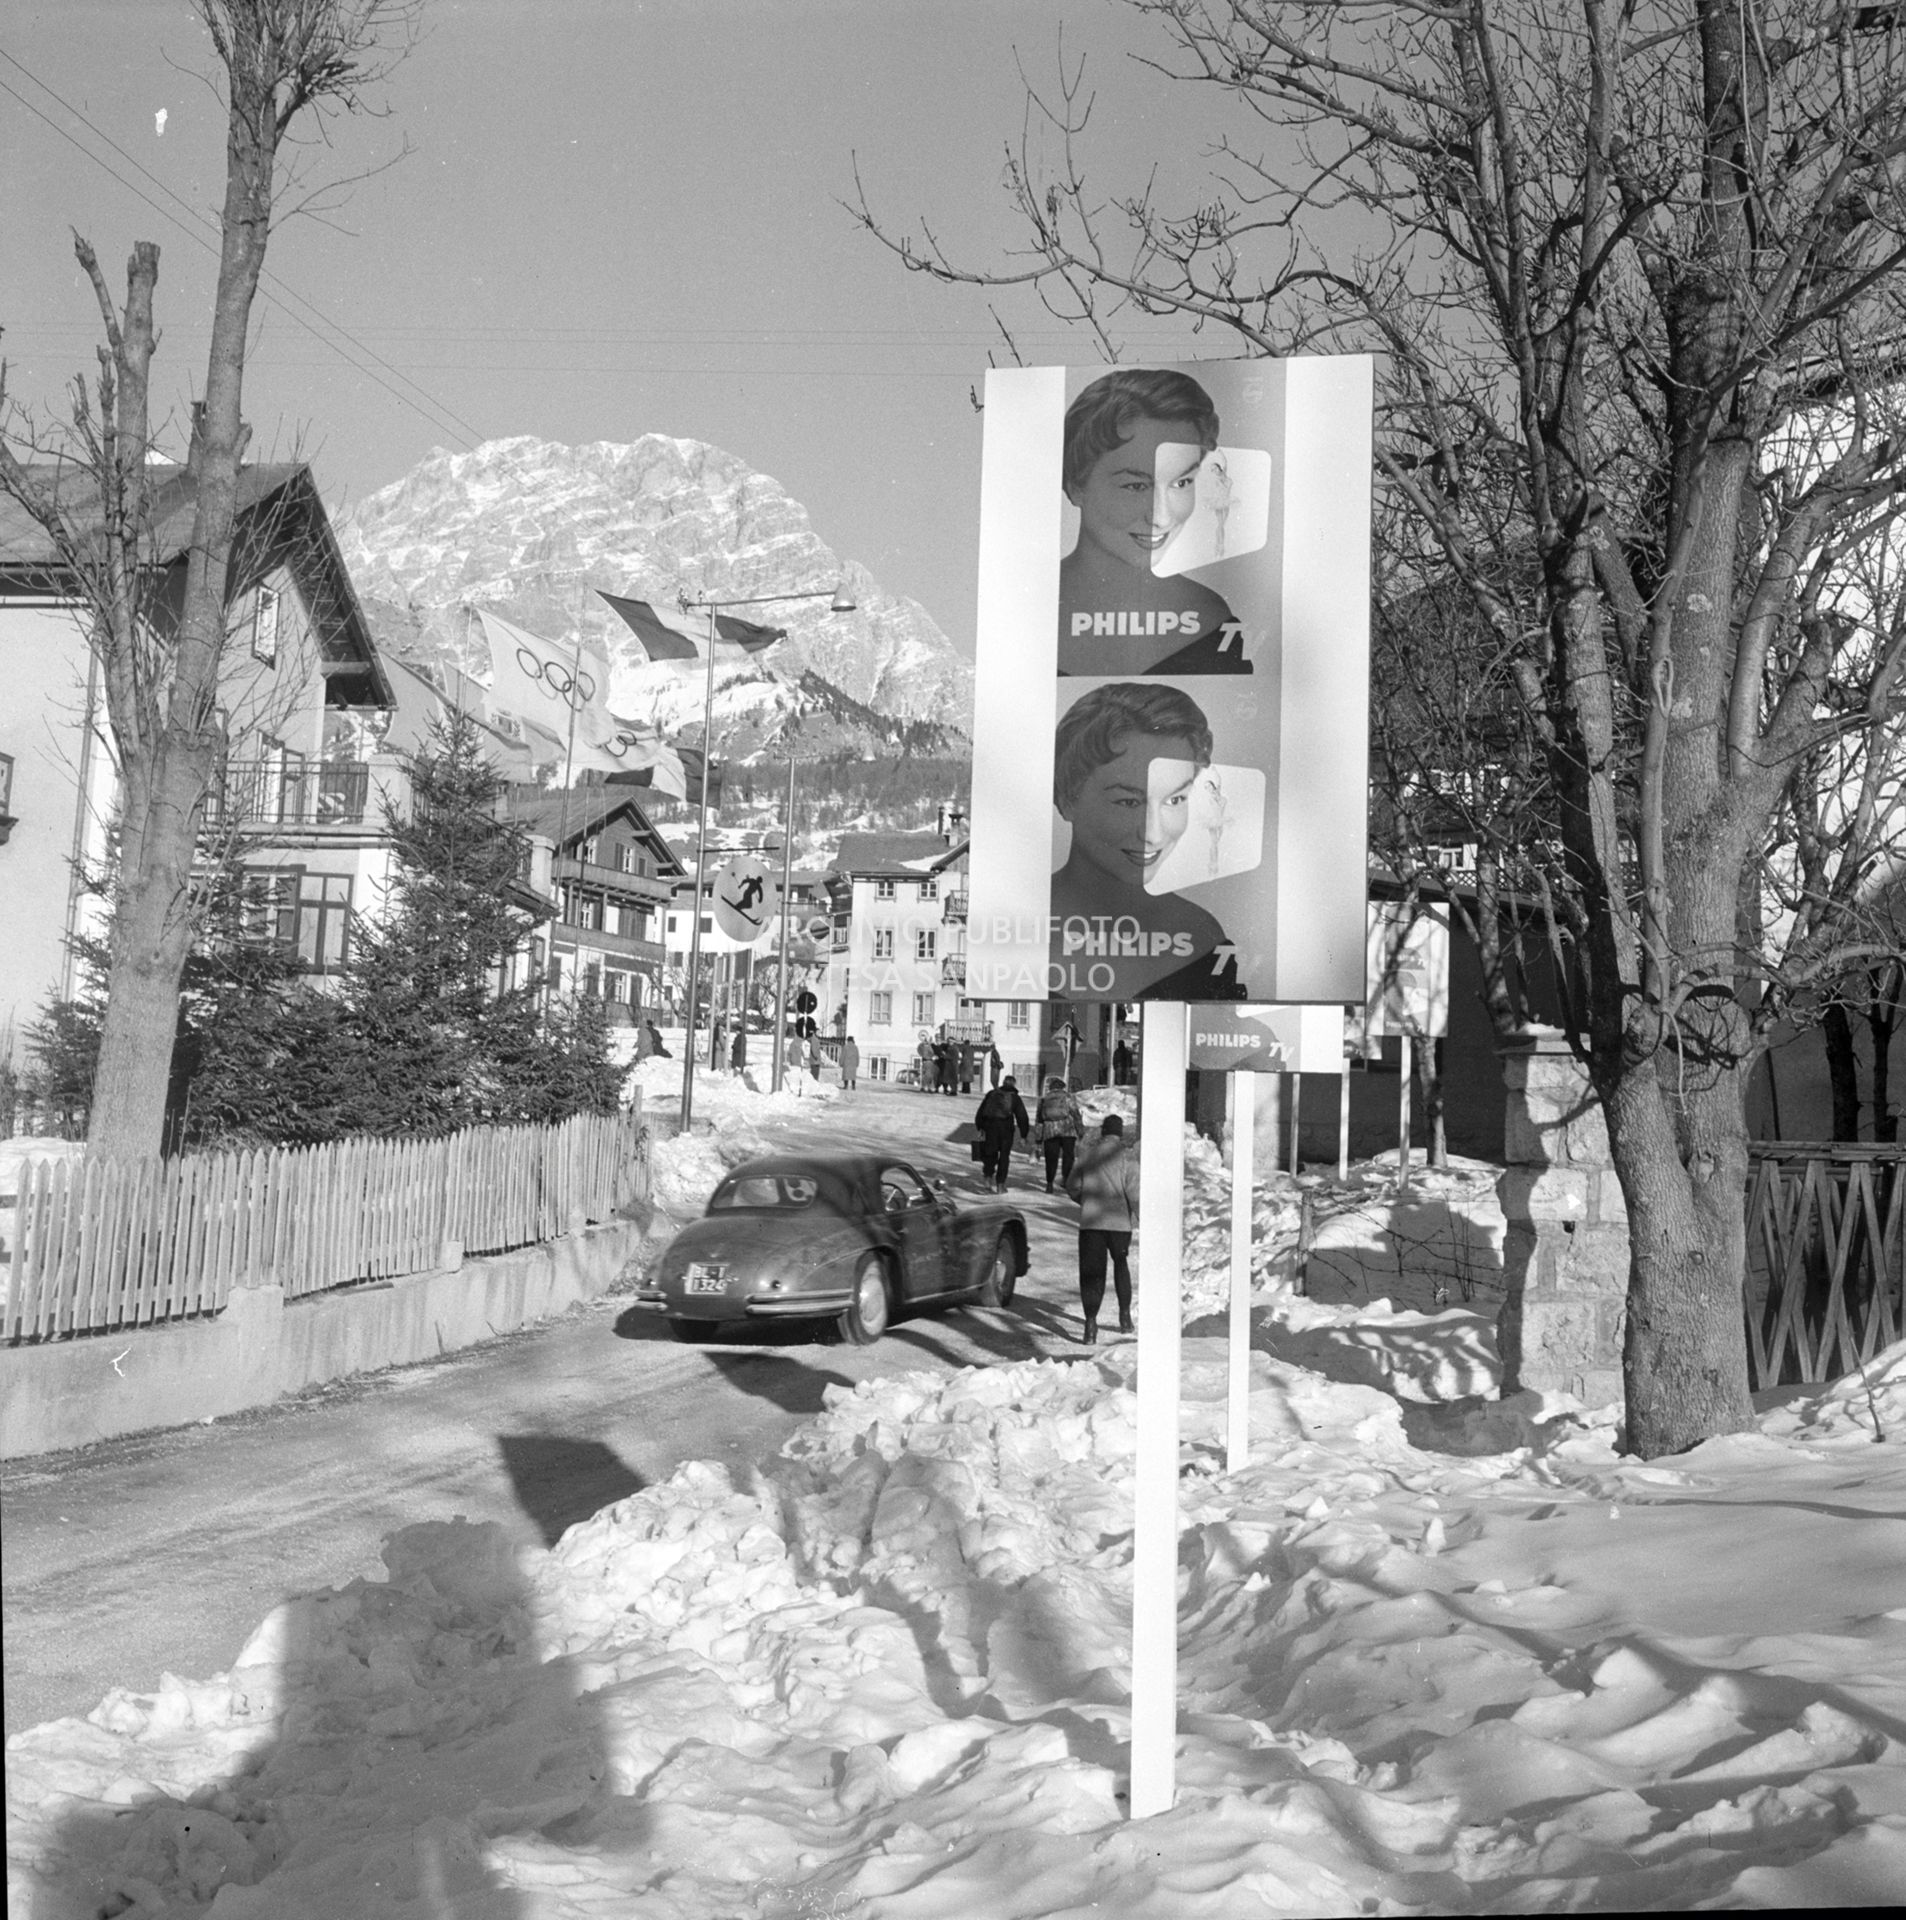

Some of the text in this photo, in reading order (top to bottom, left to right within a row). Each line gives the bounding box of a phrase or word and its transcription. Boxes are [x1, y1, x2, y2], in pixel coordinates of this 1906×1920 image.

[1071, 611, 1201, 636] PHILIPS
[1062, 931, 1195, 958] PHILIPS
[1195, 1033, 1296, 1062] PHILIPS TV
